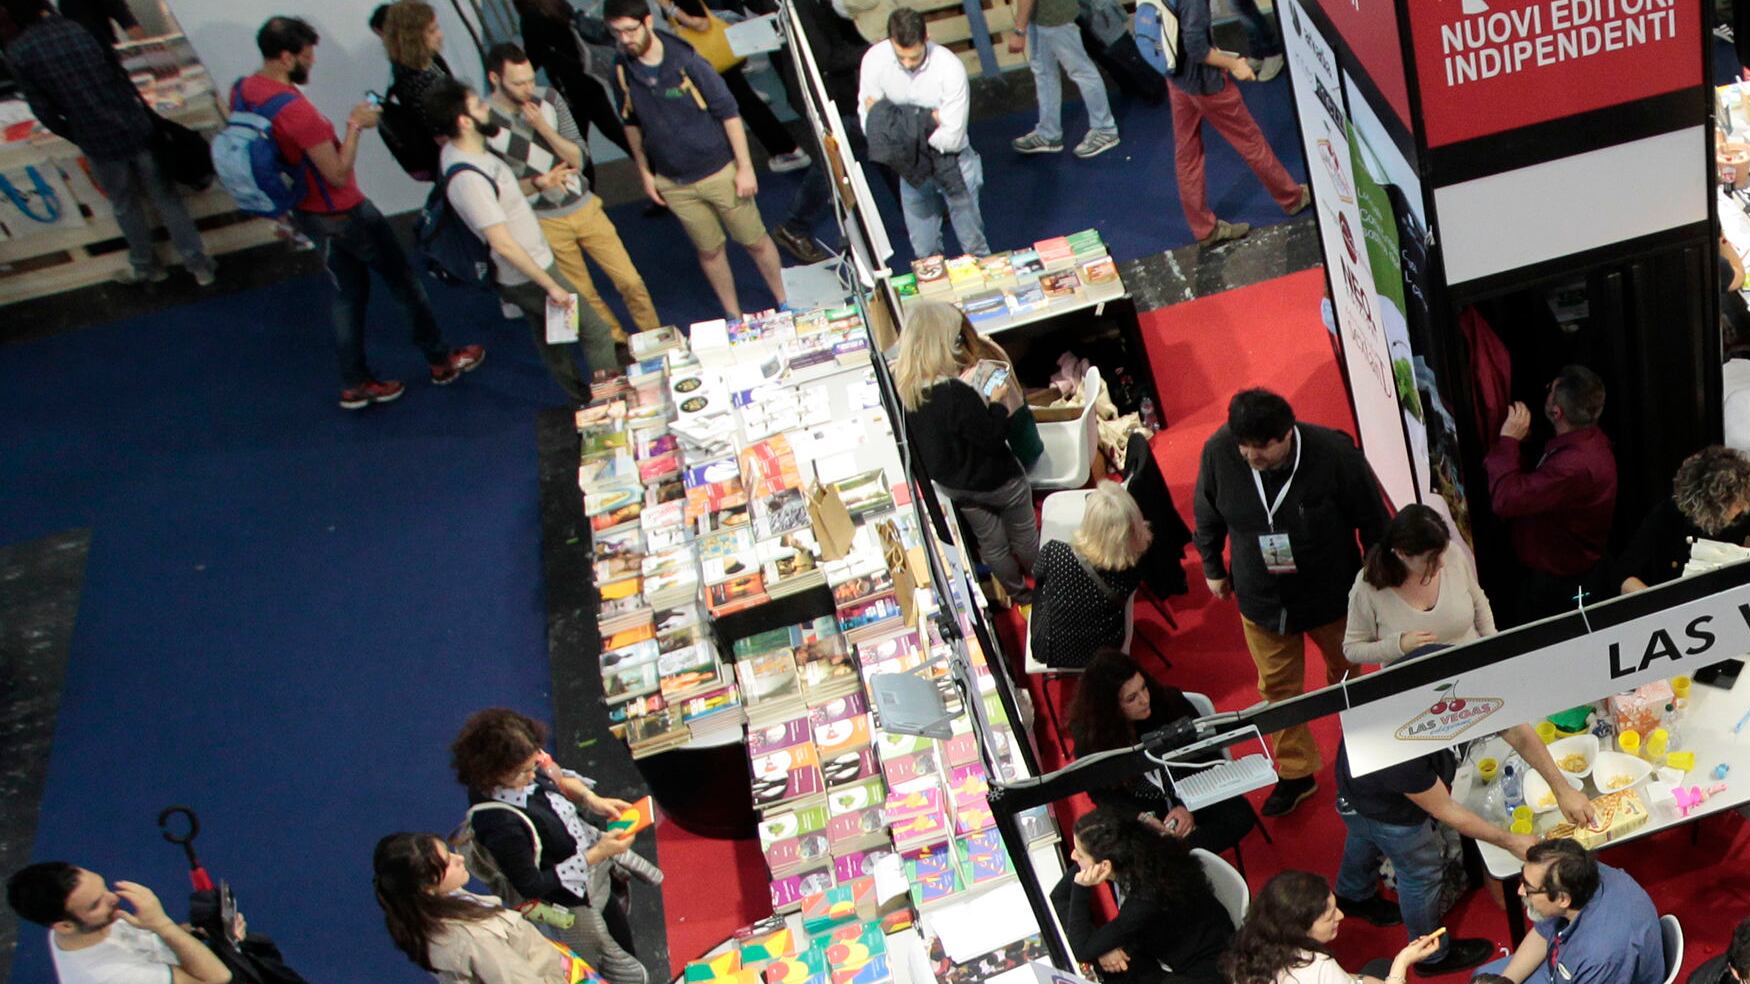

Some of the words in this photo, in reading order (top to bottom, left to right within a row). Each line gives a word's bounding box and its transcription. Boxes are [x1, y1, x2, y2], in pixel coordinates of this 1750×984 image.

[1441, 5, 1542, 54] NUOVI
[1551, 0, 1675, 31] EDITO
[1444, 9, 1676, 87] INDIPENDENTI
[1608, 615, 1716, 680] LAS
[1408, 719, 1437, 736] LAS
[1440, 703, 1491, 726] VEGAS
